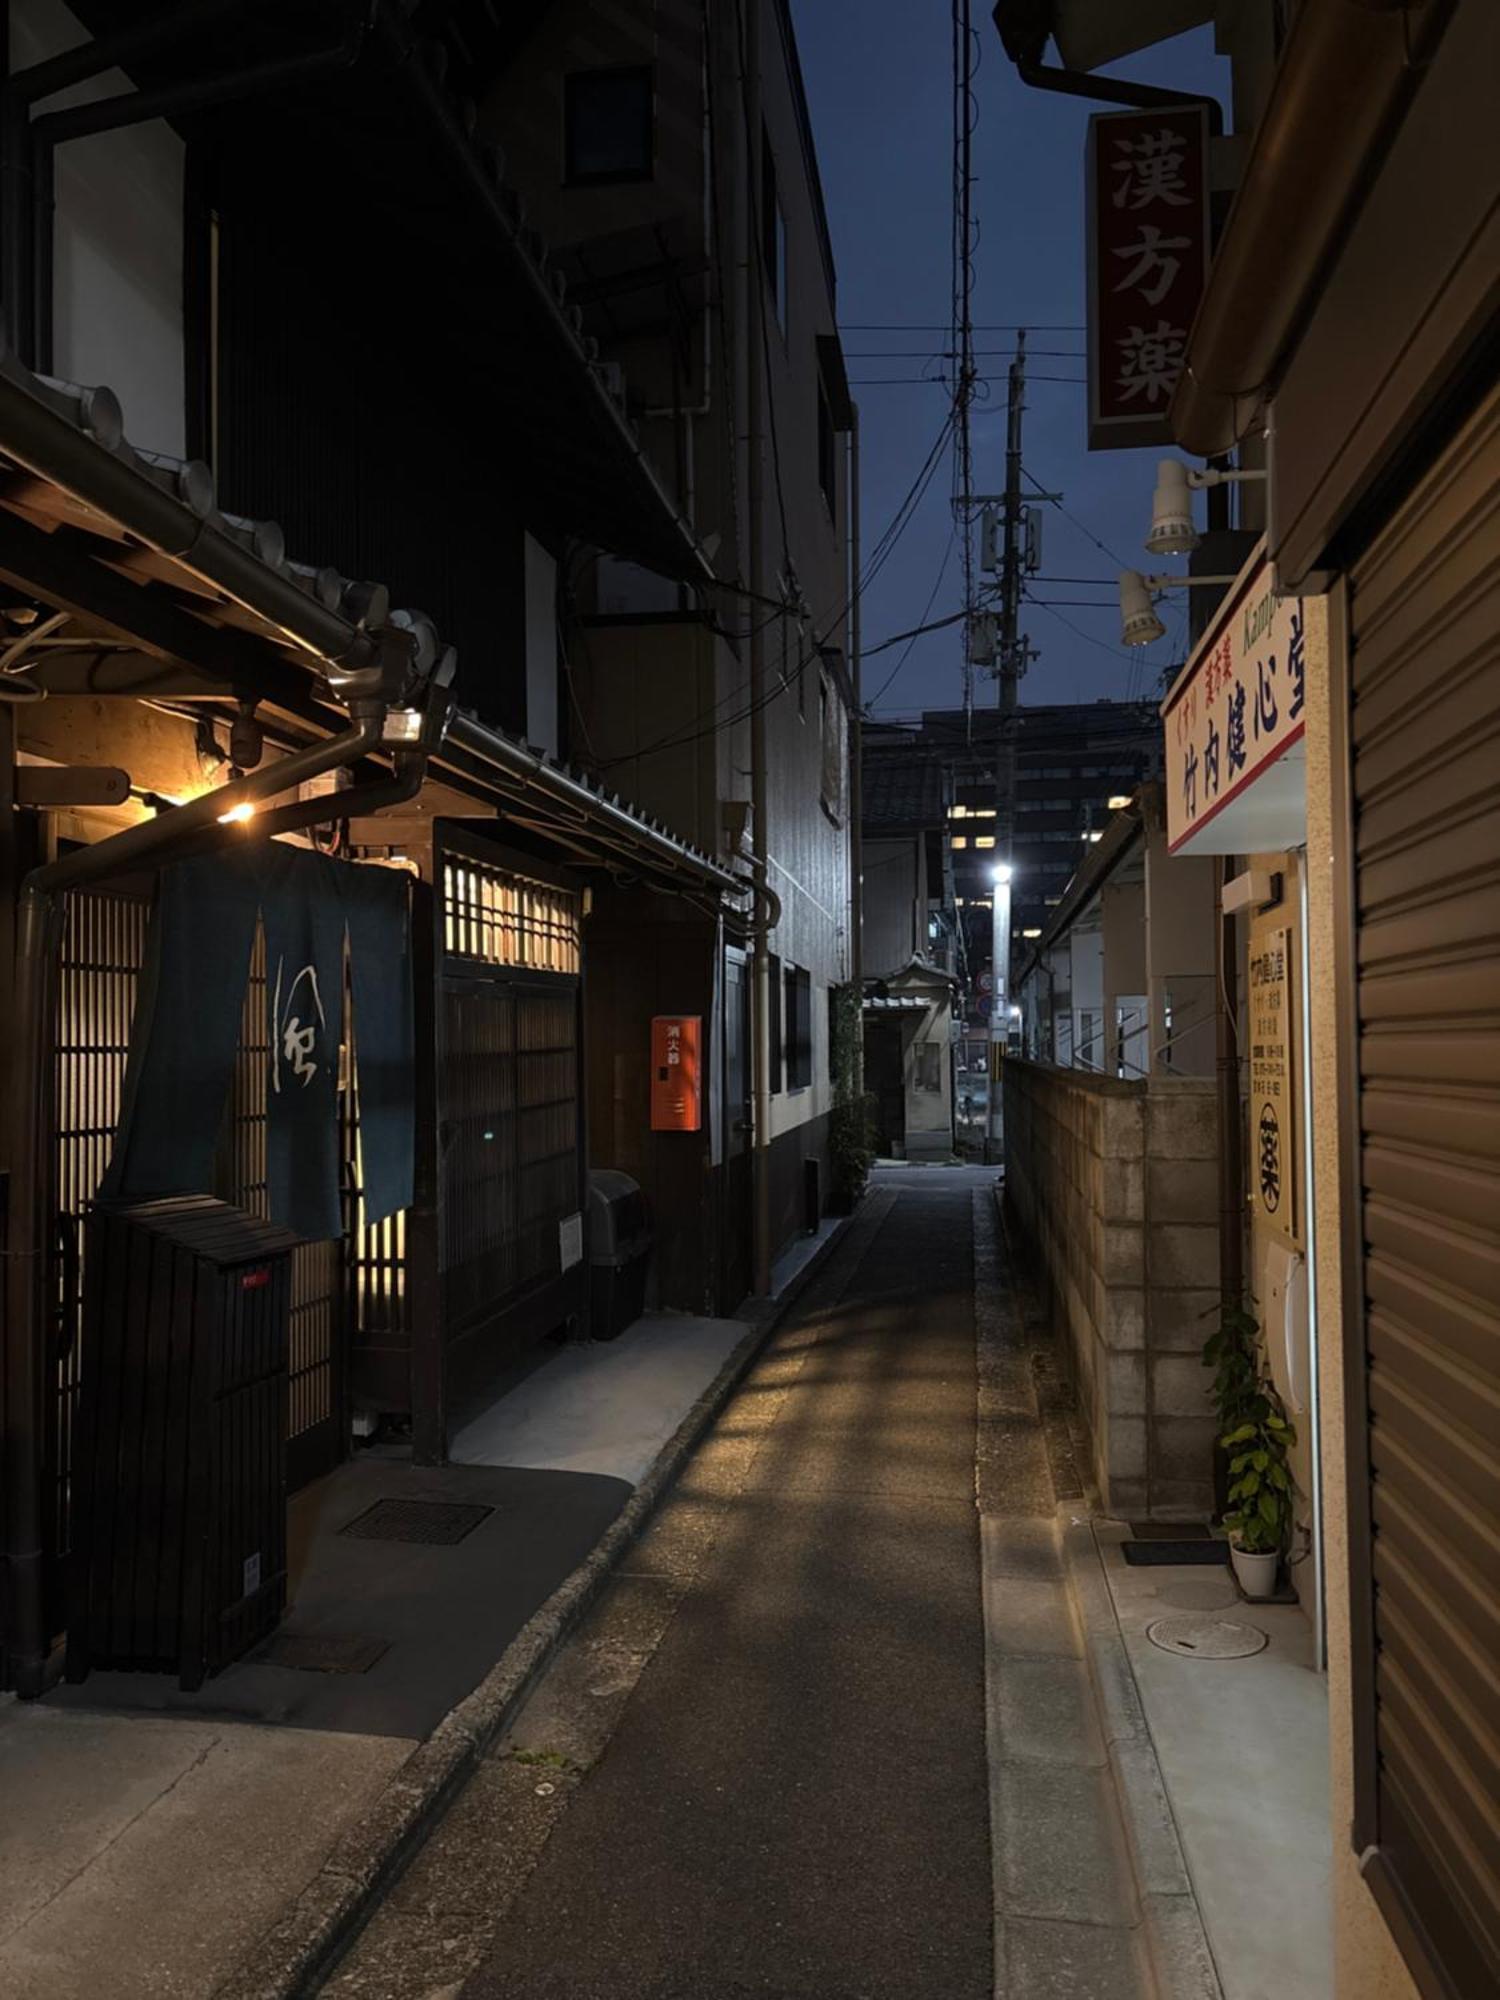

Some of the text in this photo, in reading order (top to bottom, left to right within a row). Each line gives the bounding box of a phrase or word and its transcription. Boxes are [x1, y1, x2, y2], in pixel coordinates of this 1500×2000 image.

[1110, 127, 1195, 404] 漢方薬
[666, 1024, 681, 1066] 消火器
